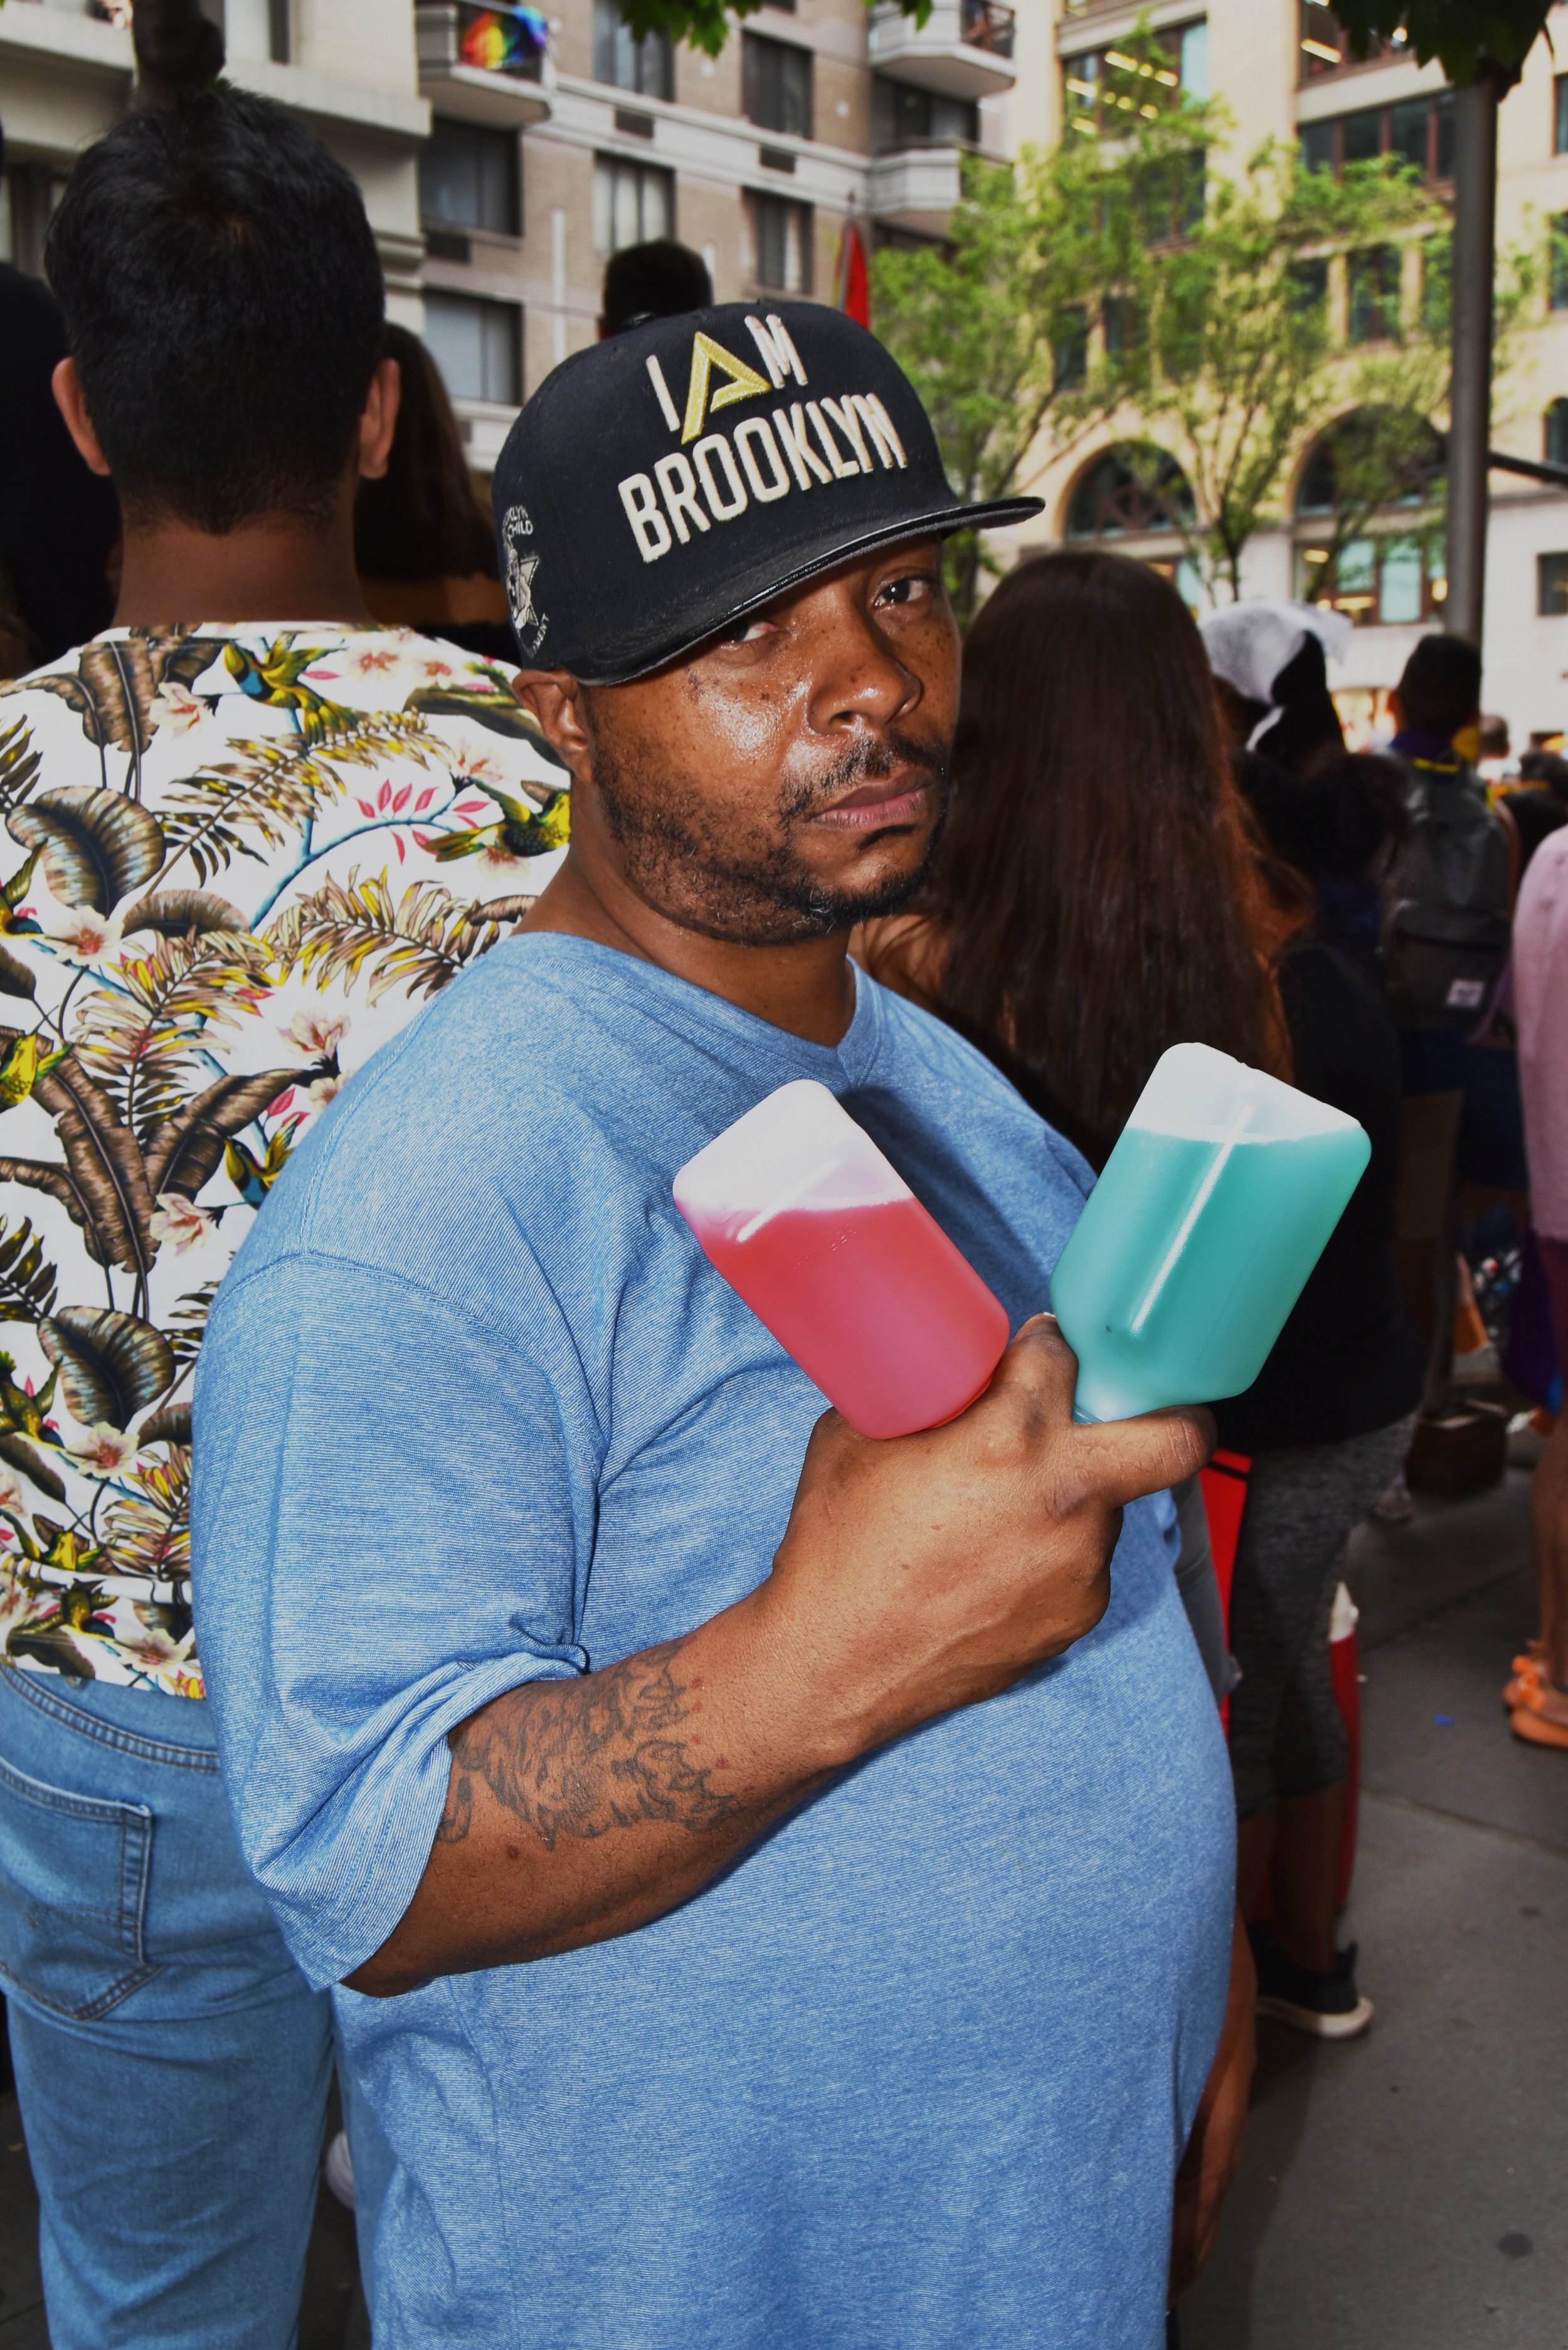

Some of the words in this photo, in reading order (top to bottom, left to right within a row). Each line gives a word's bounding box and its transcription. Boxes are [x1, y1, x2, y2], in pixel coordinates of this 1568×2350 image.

[646, 354, 680, 432] I
[681, 314, 808, 445] AM
[507, 520, 533, 538] CHILD
[618, 393, 908, 563] BROOKLYN
